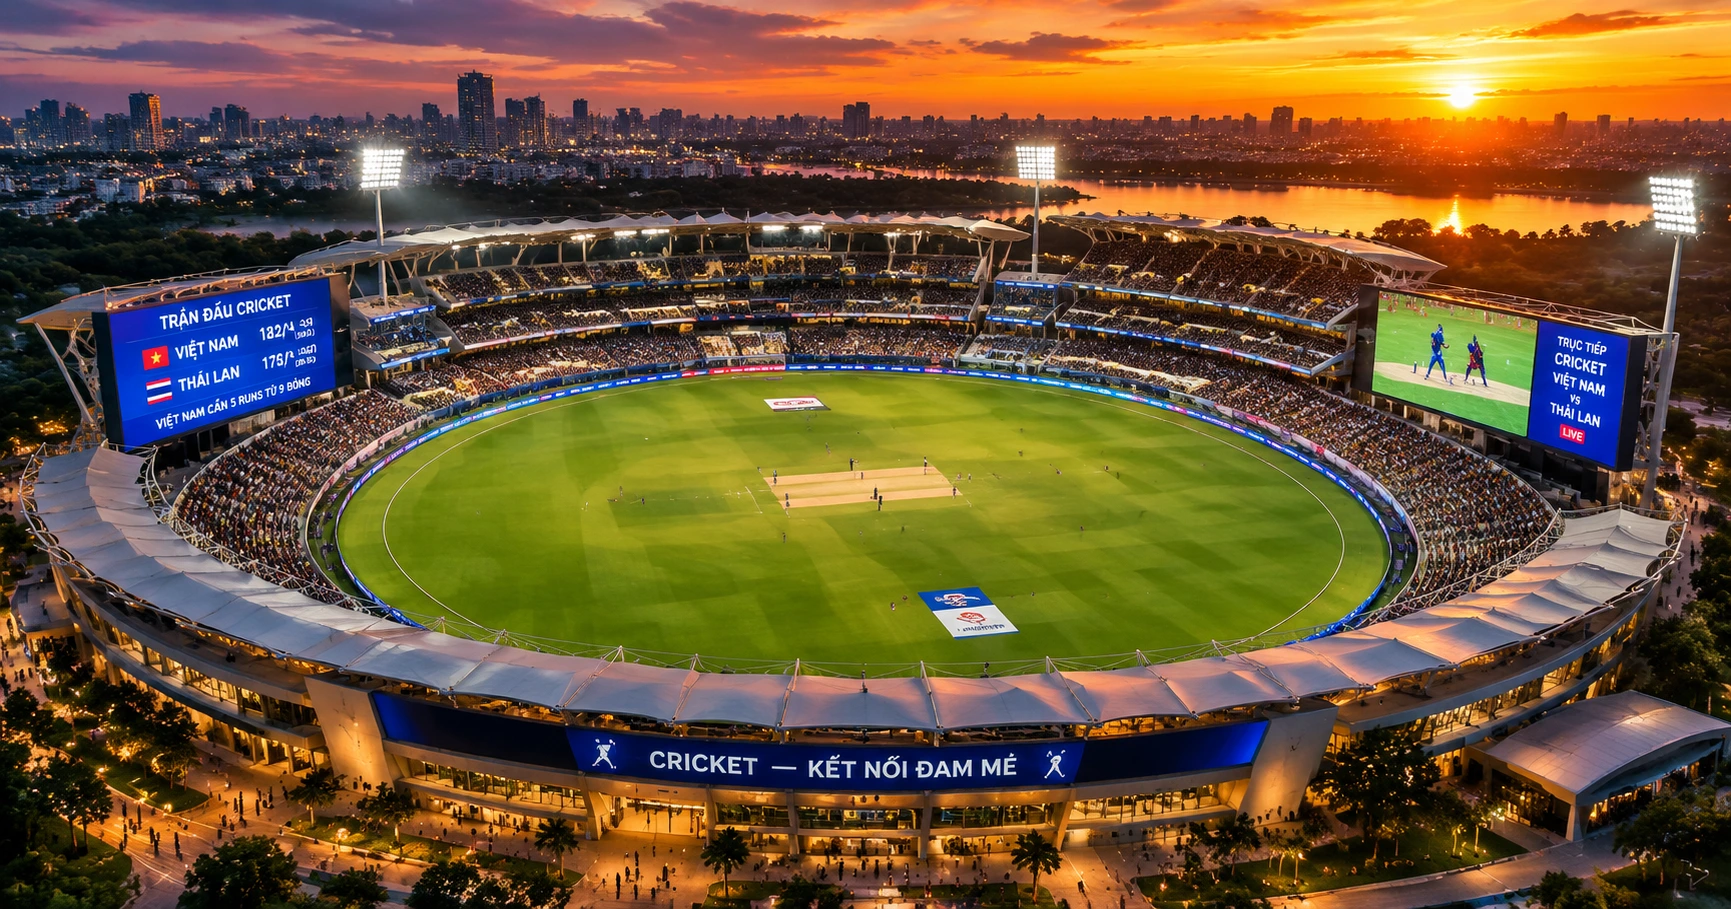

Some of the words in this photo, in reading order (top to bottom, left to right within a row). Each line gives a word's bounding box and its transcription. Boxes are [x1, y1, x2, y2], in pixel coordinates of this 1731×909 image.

[236, 294, 291, 315] CRICKET
[174, 339, 205, 360] VIỆT
[208, 334, 239, 353] NAM
[1557, 336, 1583, 352] TRỤC
[1555, 352, 1607, 376] CRICKET
[178, 370, 210, 391] THÁI
[213, 365, 240, 383] LAN
[1579, 379, 1606, 397] NAM
[182, 406, 205, 422] NAM
[230, 397, 236, 407] 5
[238, 390, 263, 405] RUNS
[279, 384, 284, 394] 9
[1578, 410, 1601, 428] LAN
[1563, 427, 1583, 442] LIVE
[650, 751, 758, 775] CRICKET
[915, 759, 973, 778] ĐAM
